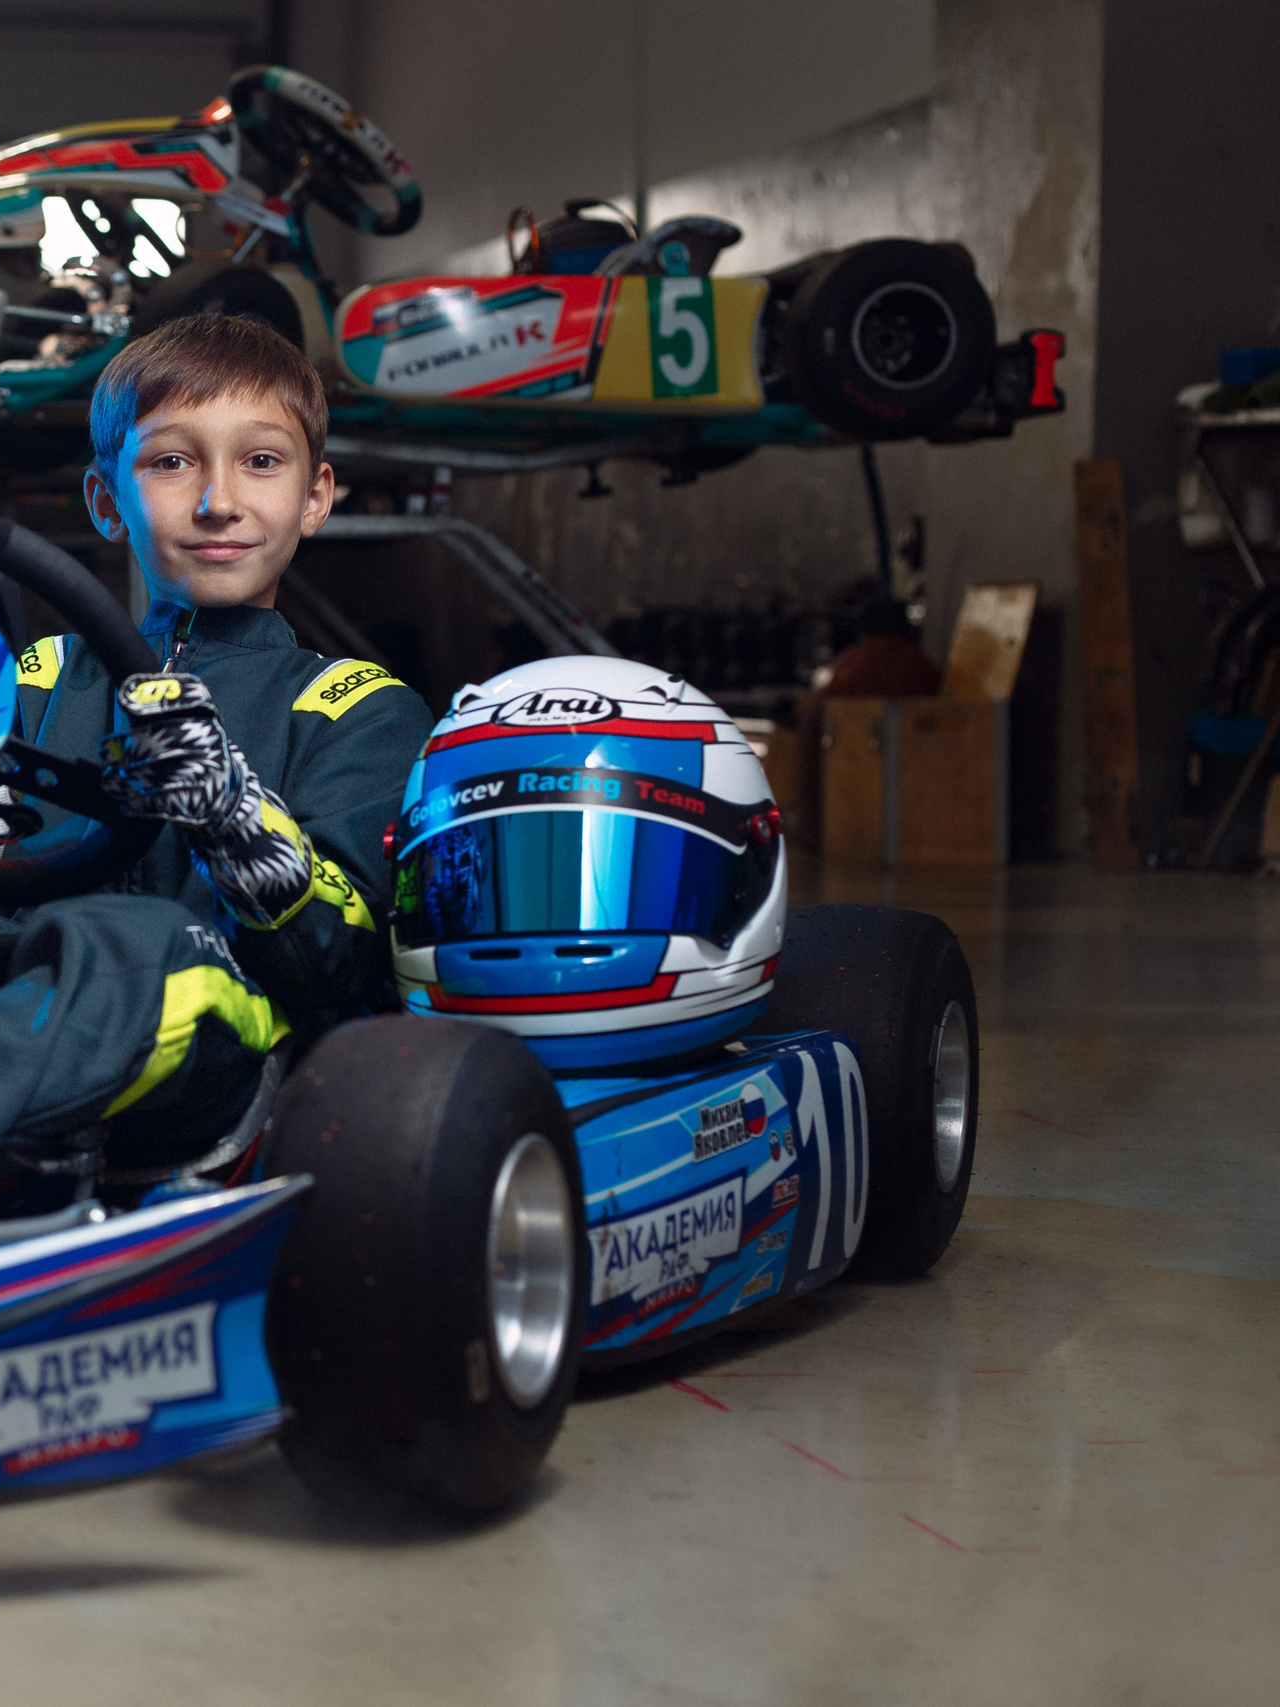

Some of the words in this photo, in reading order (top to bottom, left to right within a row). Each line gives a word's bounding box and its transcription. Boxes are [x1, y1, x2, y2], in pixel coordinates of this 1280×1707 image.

[658, 278, 711, 387] 5
[499, 690, 606, 722] Arai
[408, 779, 504, 829] Gotovcev
[517, 772, 622, 801] Racing
[635, 780, 706, 816] Team
[796, 1041, 870, 1271] 10
[606, 1190, 736, 1278] АКАДЕМИЯ
